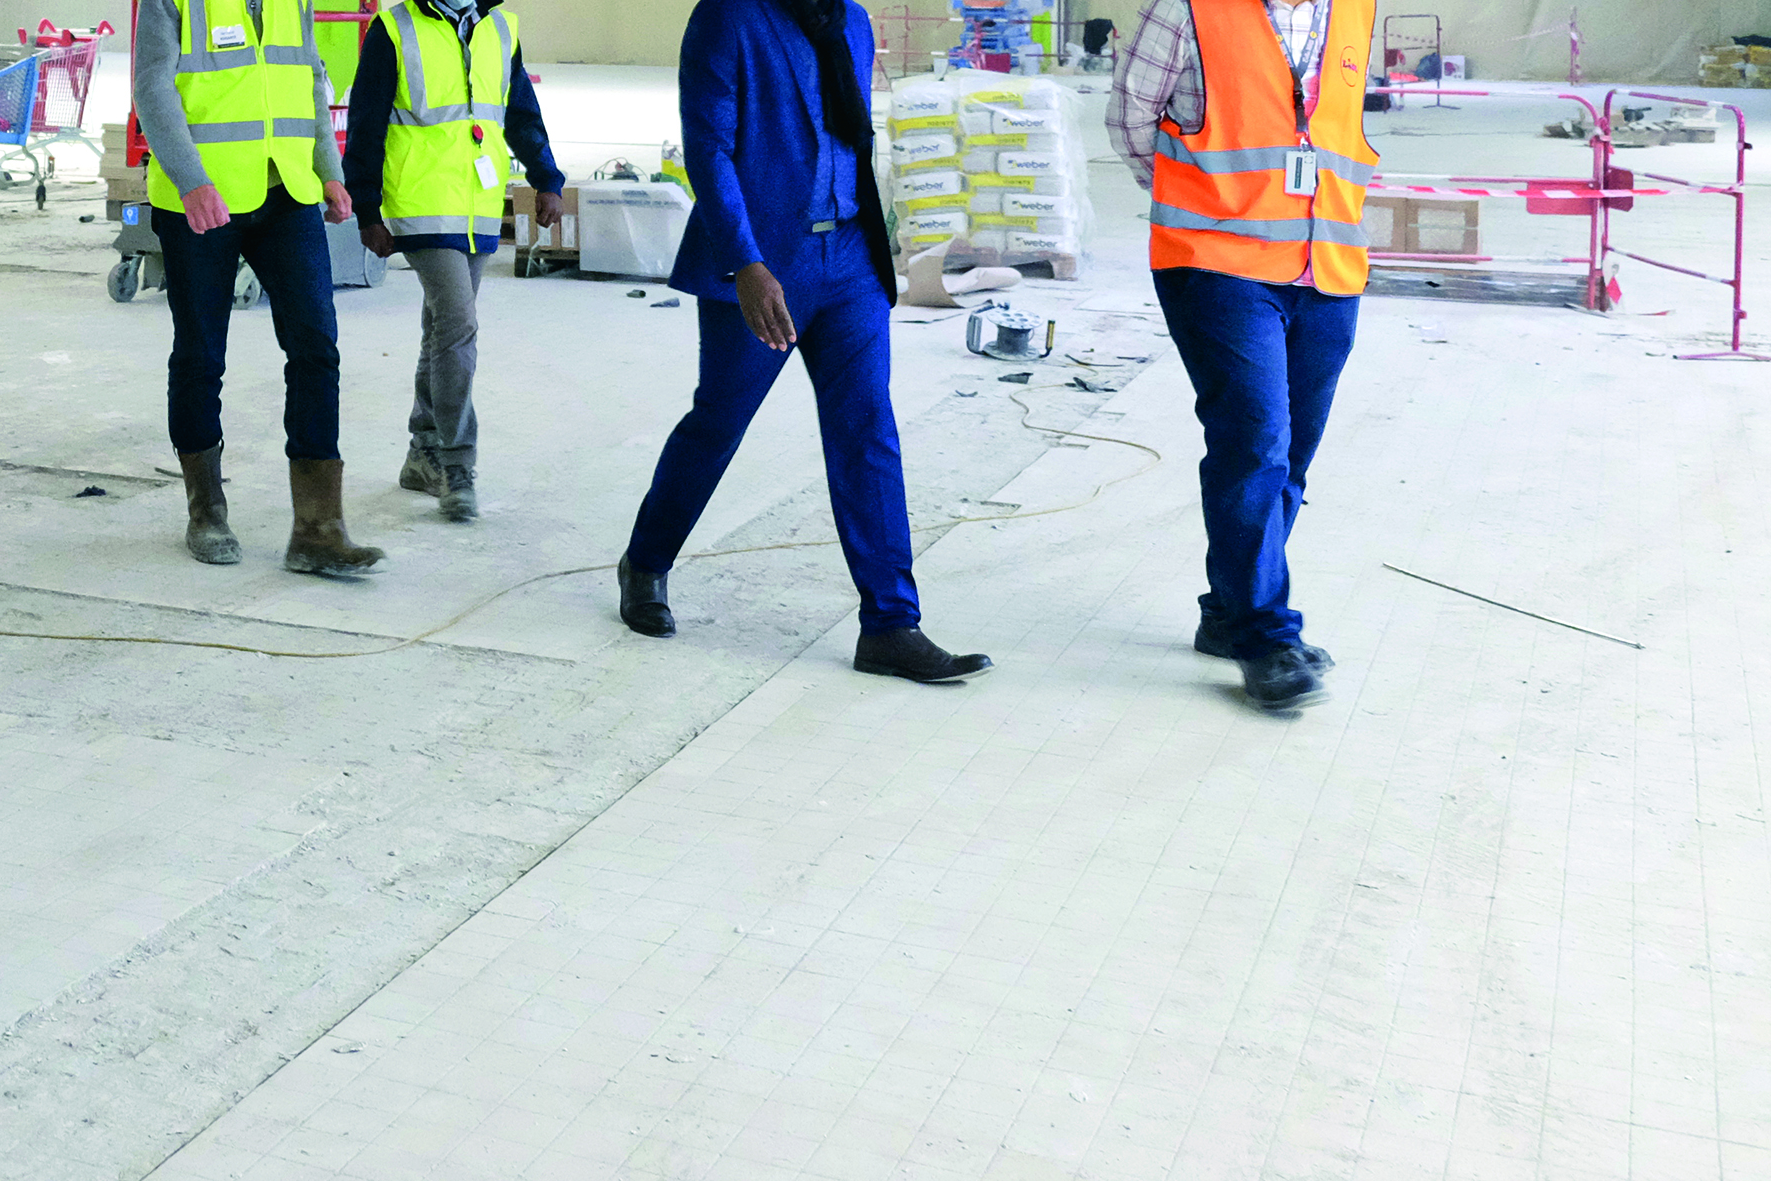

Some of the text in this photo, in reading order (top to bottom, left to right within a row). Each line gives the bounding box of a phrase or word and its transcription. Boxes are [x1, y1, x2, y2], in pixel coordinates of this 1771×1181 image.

[1011, 119, 1045, 127] weber
[1016, 161, 1050, 169] weber
[913, 182, 944, 192] weber
[1020, 202, 1055, 211] weber
[918, 220, 951, 229] weber
[1023, 239, 1058, 248] weber
